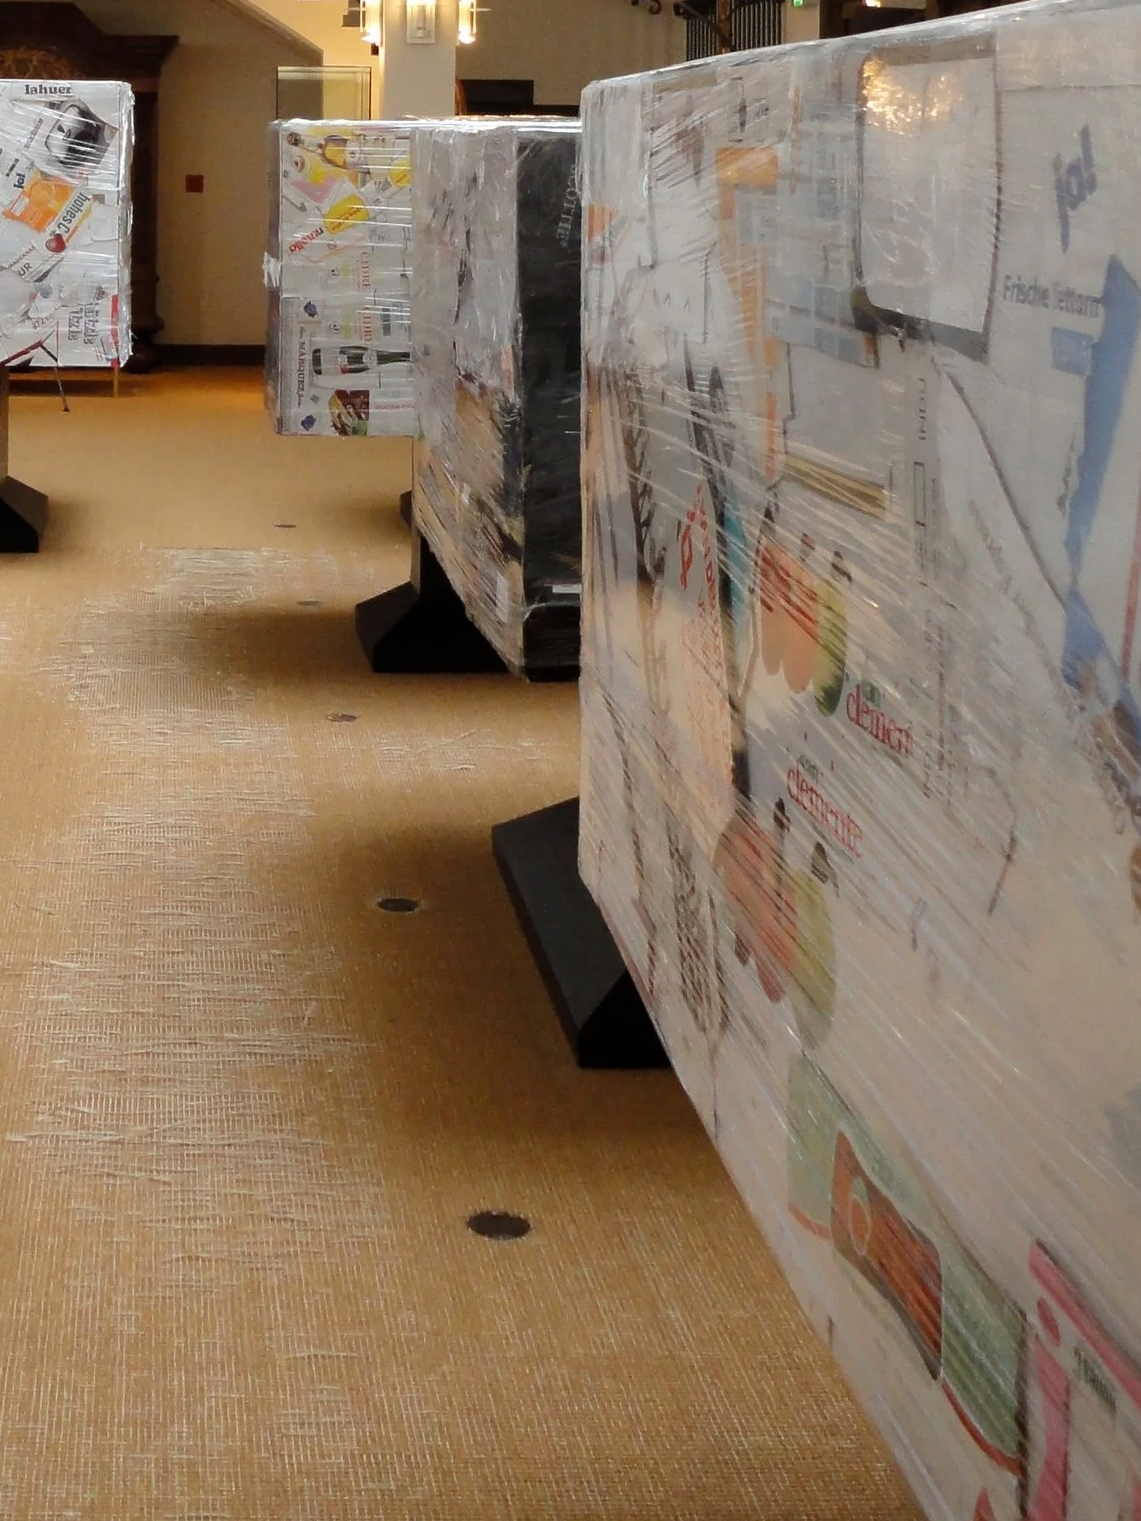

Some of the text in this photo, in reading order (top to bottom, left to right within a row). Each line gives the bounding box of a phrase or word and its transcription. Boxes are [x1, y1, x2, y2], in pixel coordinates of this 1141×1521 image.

[56, 192, 92, 235] hohes C
[361, 252, 371, 290] CIDRE
